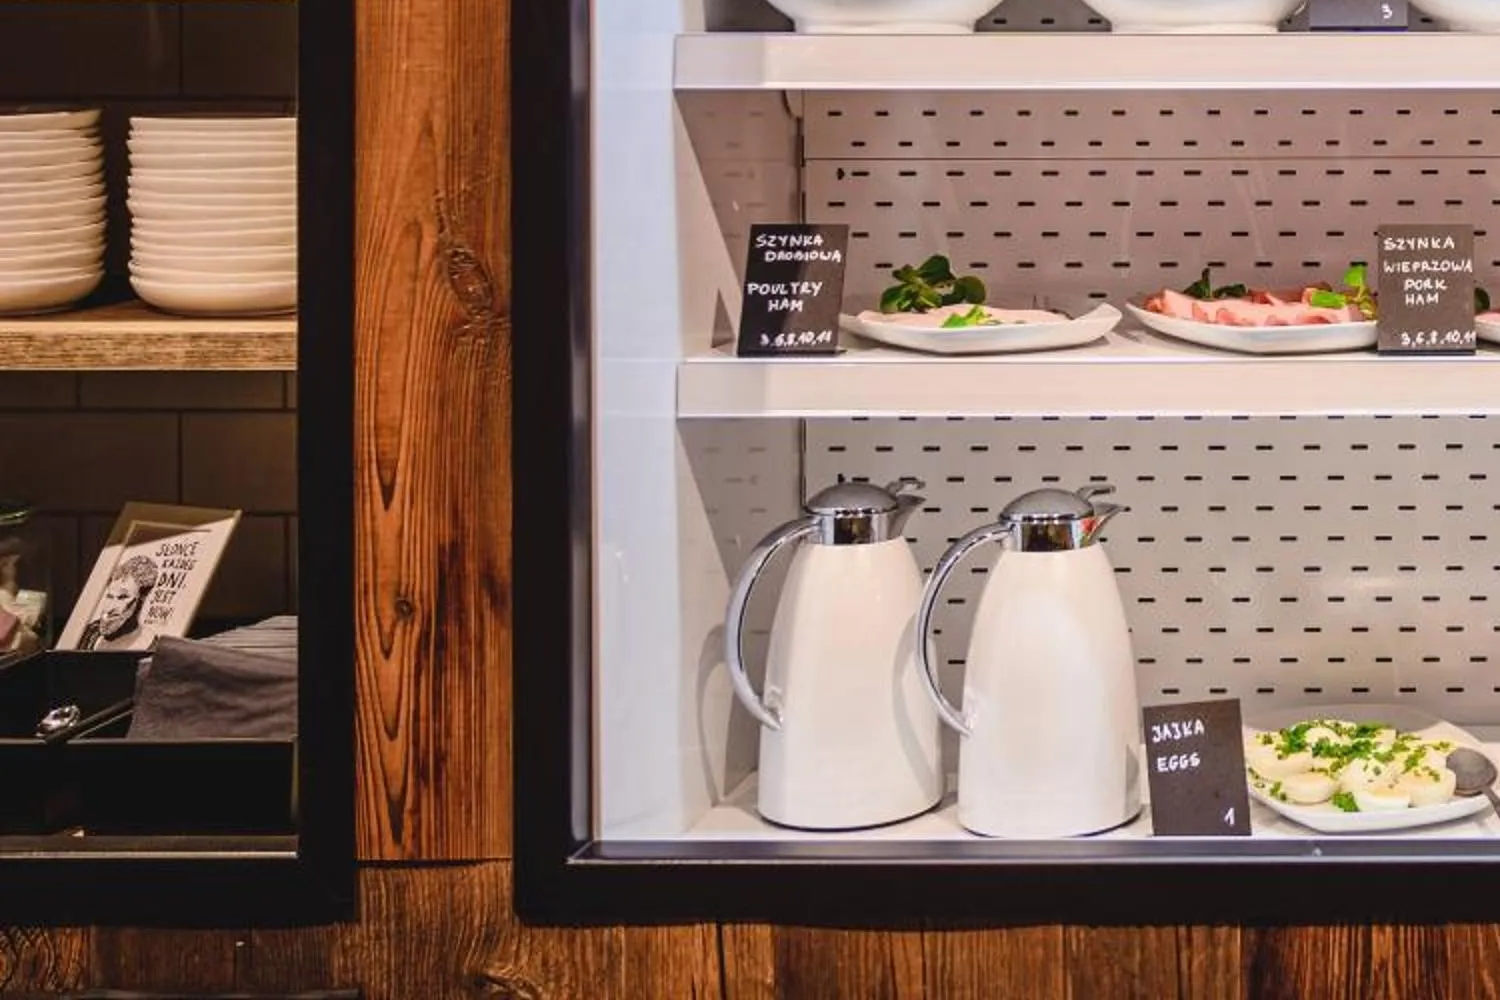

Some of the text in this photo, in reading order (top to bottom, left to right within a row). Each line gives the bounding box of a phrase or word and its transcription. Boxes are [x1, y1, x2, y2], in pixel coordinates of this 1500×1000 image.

[1381, 3, 1393, 19] 3
[755, 234, 824, 248] SZYNKA
[1383, 236, 1455, 251] SZYNKA
[764, 250, 841, 263] DROBIOWA
[1383, 258, 1473, 274] WIEPRZOWA
[747, 281, 823, 296] POULTRY
[1404, 278, 1448, 292] PORK
[767, 298, 804, 313] HAM
[1405, 292, 1440, 306] HAM
[1151, 719, 1205, 743] JAJKA
[1156, 752, 1201, 772] EGGS
[1223, 807, 1236, 826] 1
